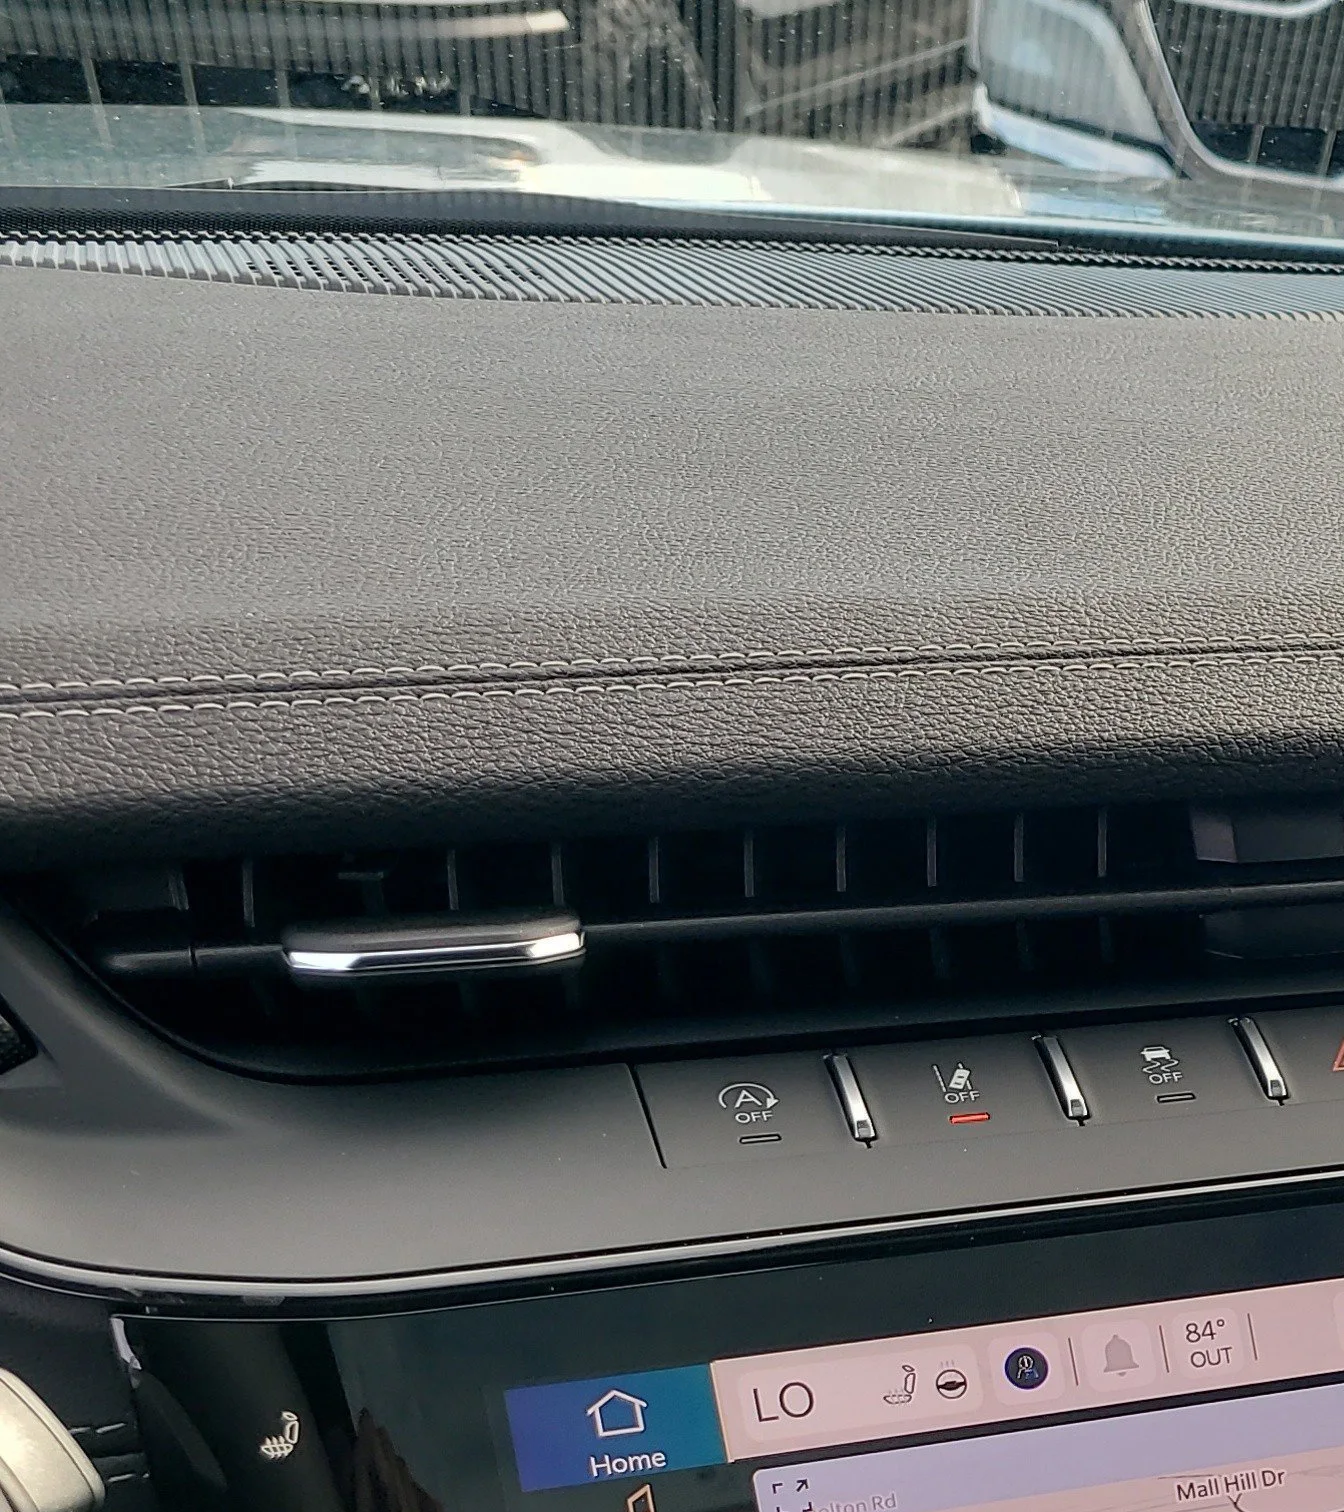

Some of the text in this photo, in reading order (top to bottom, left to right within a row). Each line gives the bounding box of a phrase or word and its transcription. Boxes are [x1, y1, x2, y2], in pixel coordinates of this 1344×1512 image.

[1149, 1070, 1183, 1085] OFF
[944, 1090, 980, 1104] OFF
[735, 1110, 774, 1124] OFF
[1185, 1318, 1226, 1344] 84°
[1190, 1346, 1233, 1369] OUT
[753, 1381, 813, 1422] LO
[589, 1448, 667, 1478] Home
[1176, 1467, 1286, 1502] Mall Hill Dr
[871, 1493, 897, 1510] Rd
